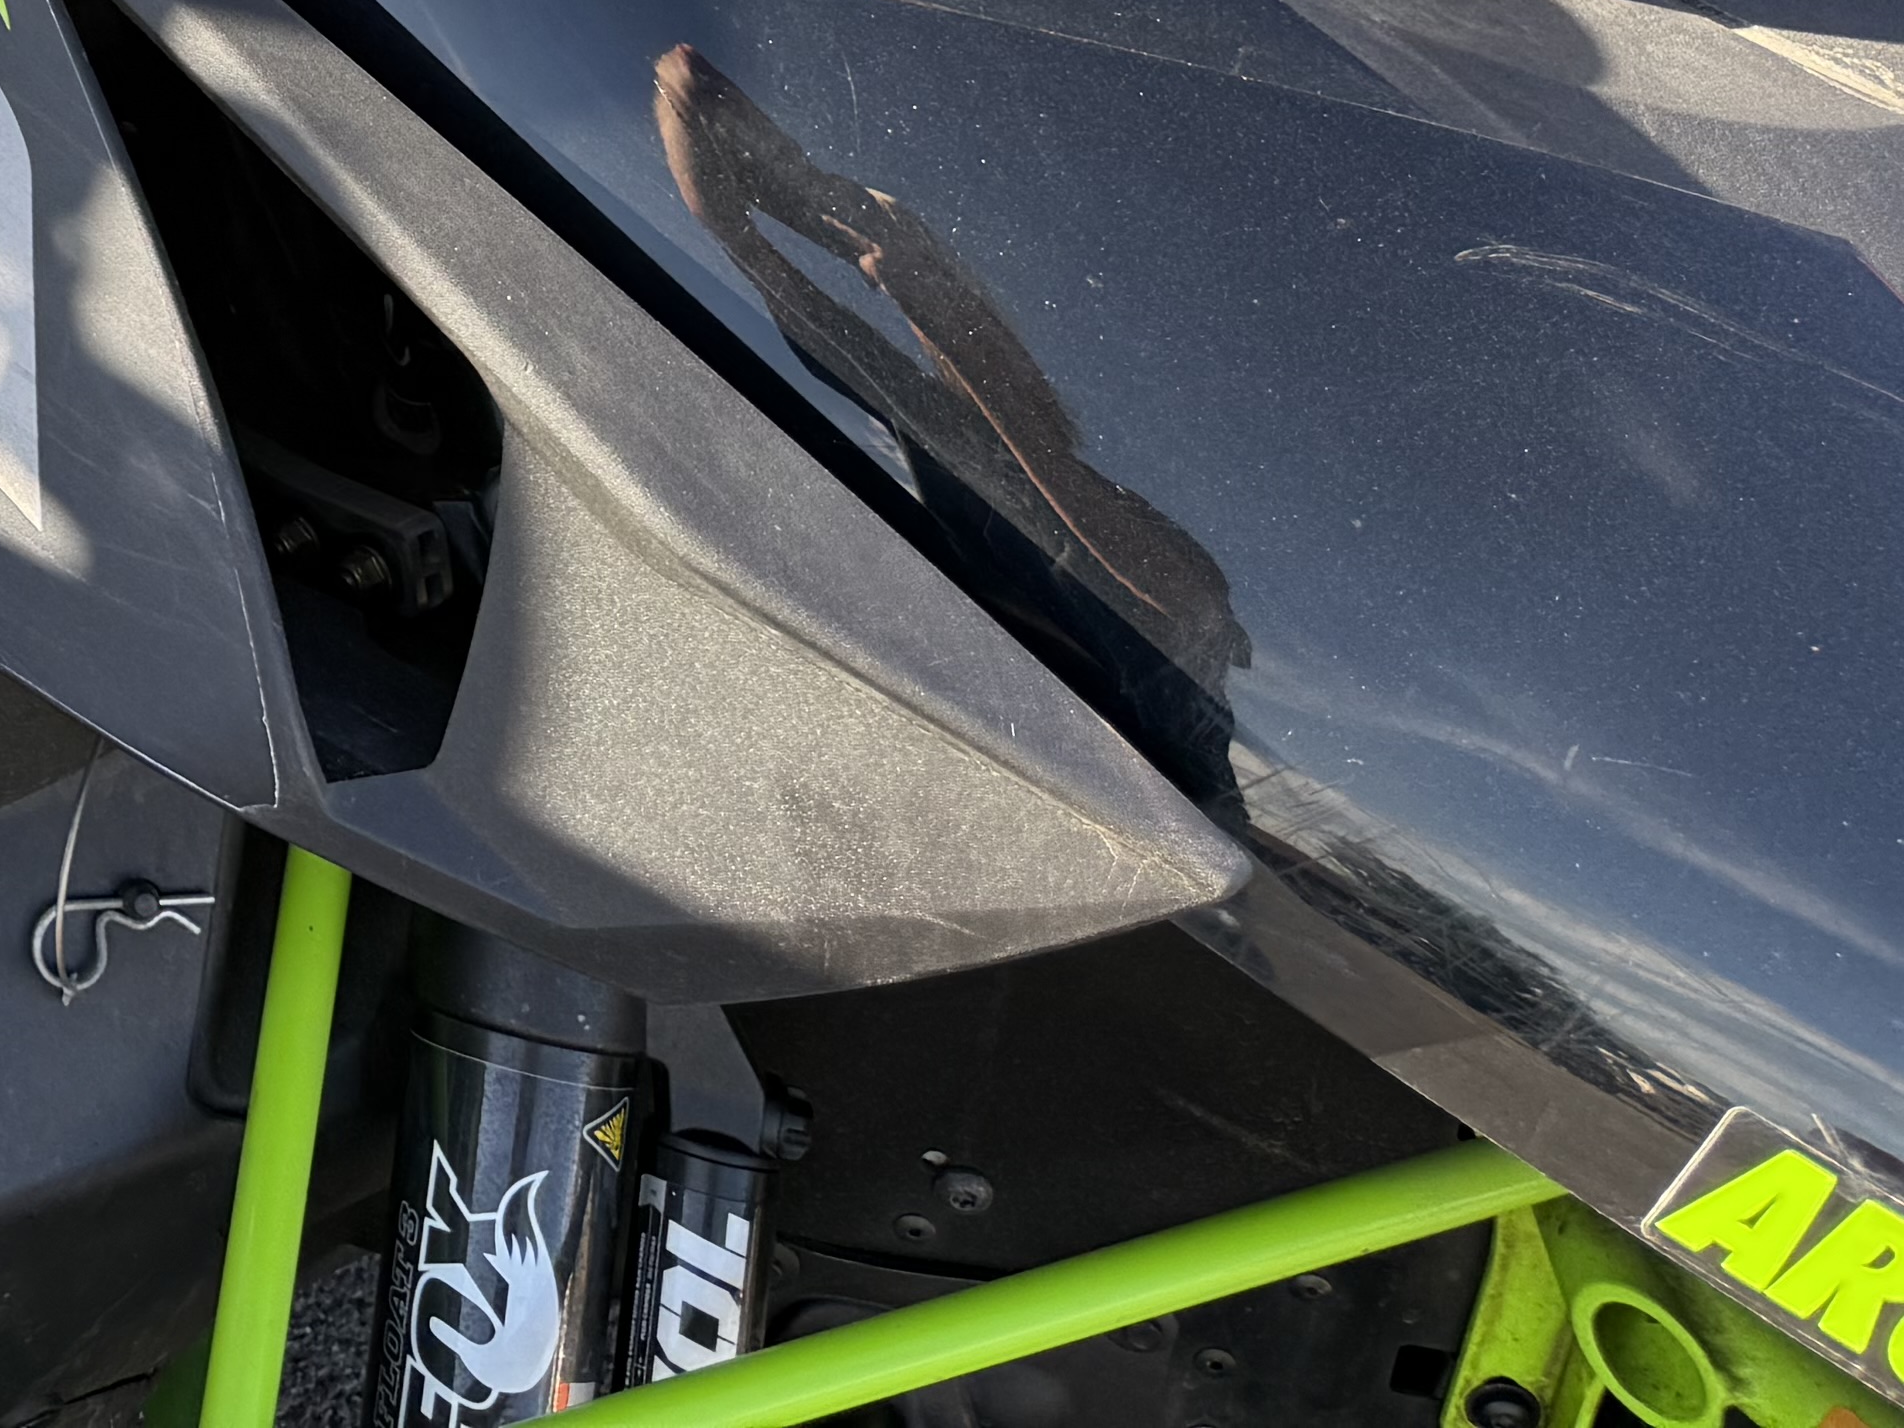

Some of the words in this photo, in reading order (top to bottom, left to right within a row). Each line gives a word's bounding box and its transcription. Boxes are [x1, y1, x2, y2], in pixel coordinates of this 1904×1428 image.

[371, 1242, 416, 1428] FLOAT
[398, 1199, 420, 1247] 3
[652, 1212, 750, 1384] OL
[1655, 1148, 1904, 1388] AR
